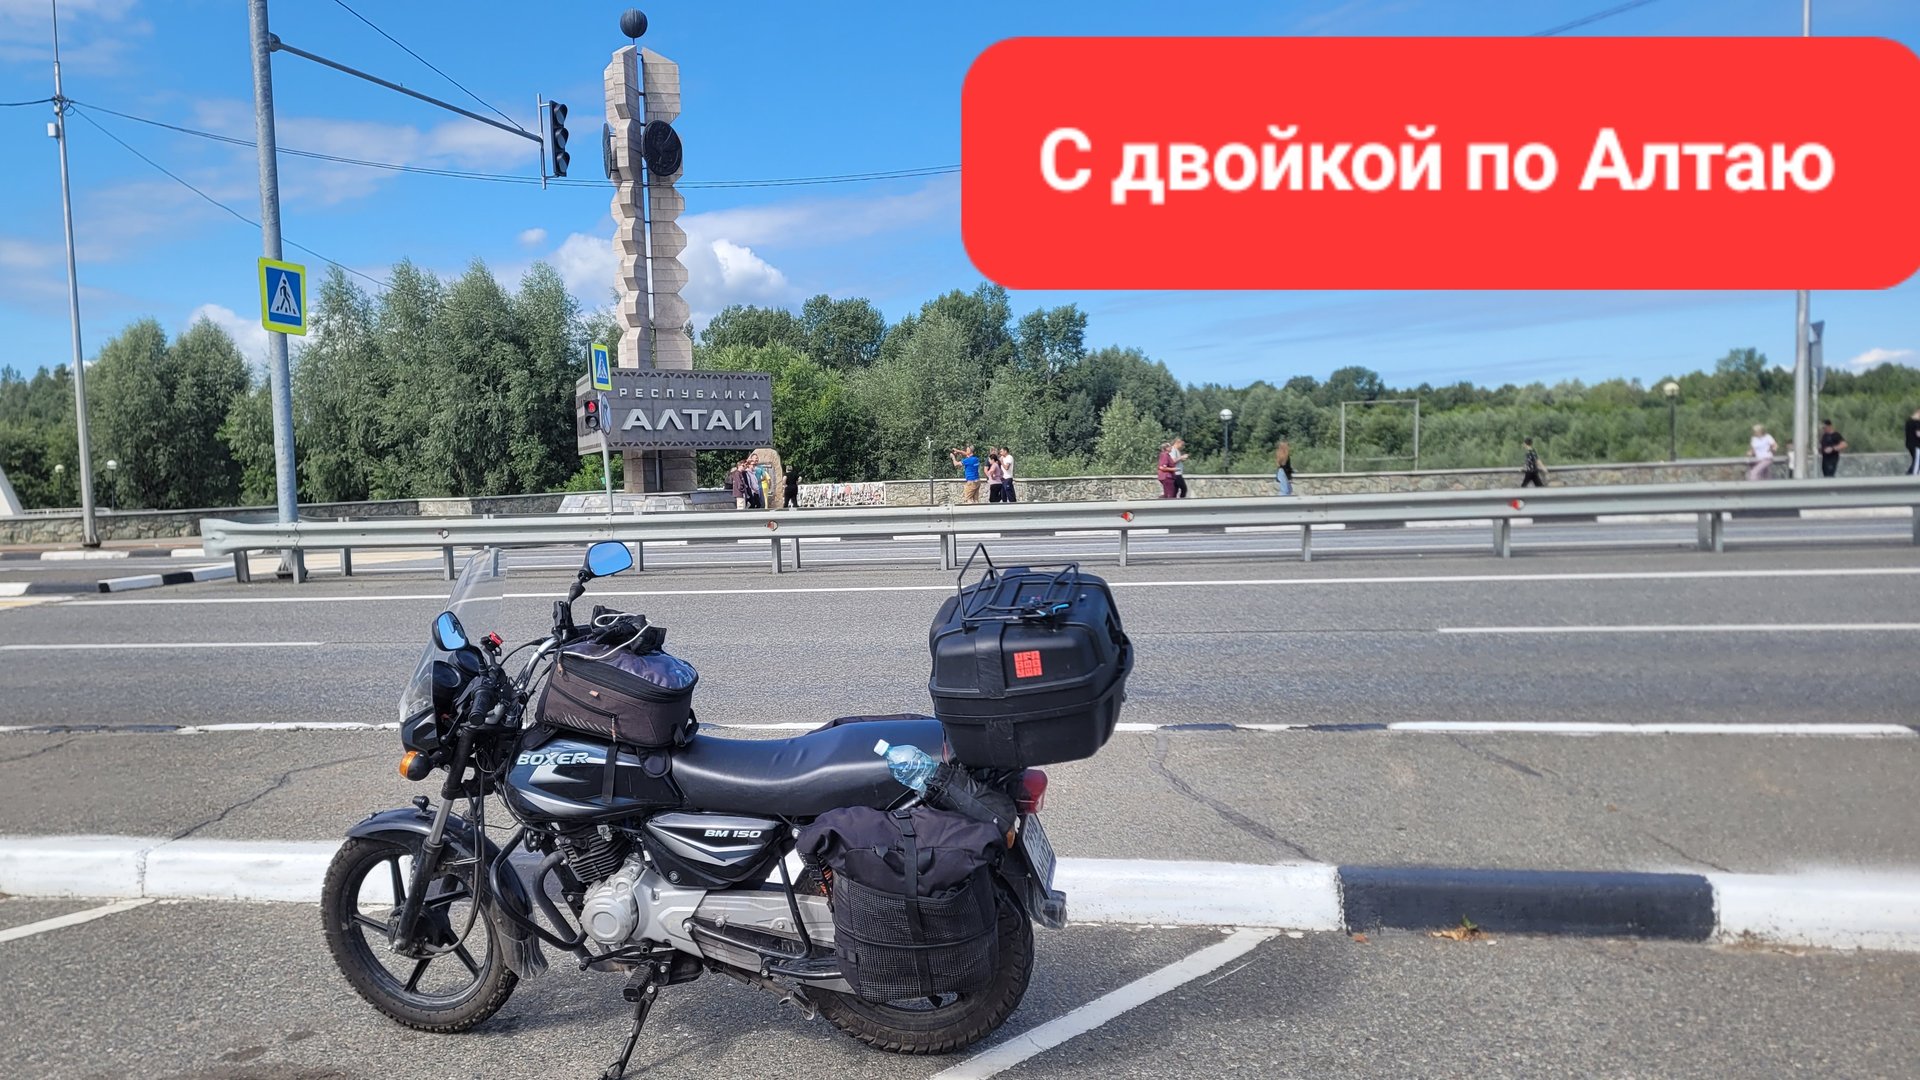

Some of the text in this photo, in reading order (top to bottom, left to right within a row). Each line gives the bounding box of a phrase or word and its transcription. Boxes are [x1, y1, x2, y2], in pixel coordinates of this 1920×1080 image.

[619, 388, 760, 400] РЕСПУБЛИКА
[621, 402, 762, 431] АЛТАЙ
[516, 752, 589, 766] BOXER
[704, 829, 762, 838] BM 150
